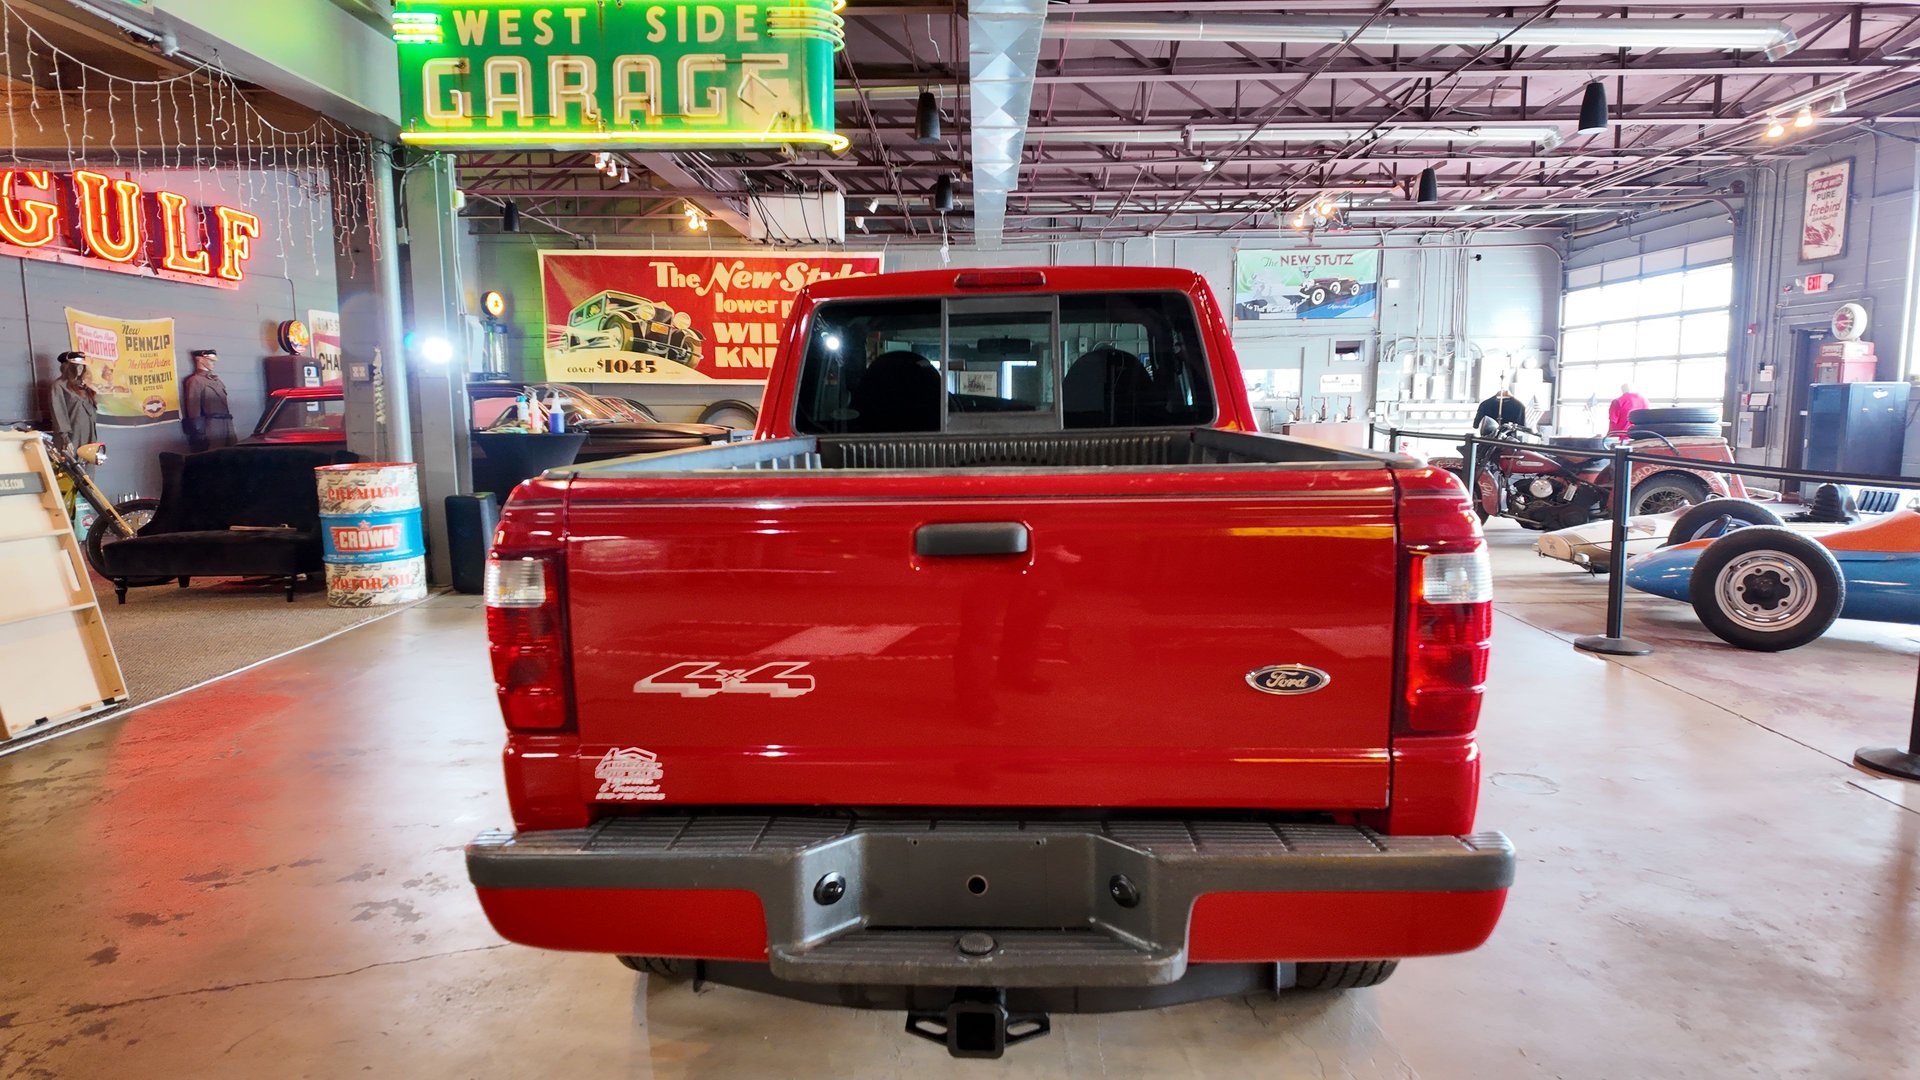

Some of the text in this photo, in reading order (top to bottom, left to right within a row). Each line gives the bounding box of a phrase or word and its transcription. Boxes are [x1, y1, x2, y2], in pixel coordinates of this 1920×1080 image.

[452, 5, 758, 46] WEST SIDE
[422, 53, 790, 127] GARAGE
[1817, 190, 1836, 201] PURE
[0, 168, 260, 282] GULF
[1262, 254, 1354, 268] The NEW STUTZ
[649, 261, 702, 289] The
[695, 260, 782, 297] New
[1807, 275, 1823, 291] EXIT
[715, 292, 779, 314] lower
[122, 324, 140, 335] New
[712, 322, 787, 344] WIL
[125, 334, 170, 351] PENNZIP
[319, 352, 342, 371] CHA
[597, 358, 657, 374] $1045
[714, 346, 778, 368] KNI
[129, 375, 143, 385] NEW
[339, 528, 395, 549] CROWN
[633, 661, 816, 698] 4x4
[1266, 670, 1309, 688] Ford
